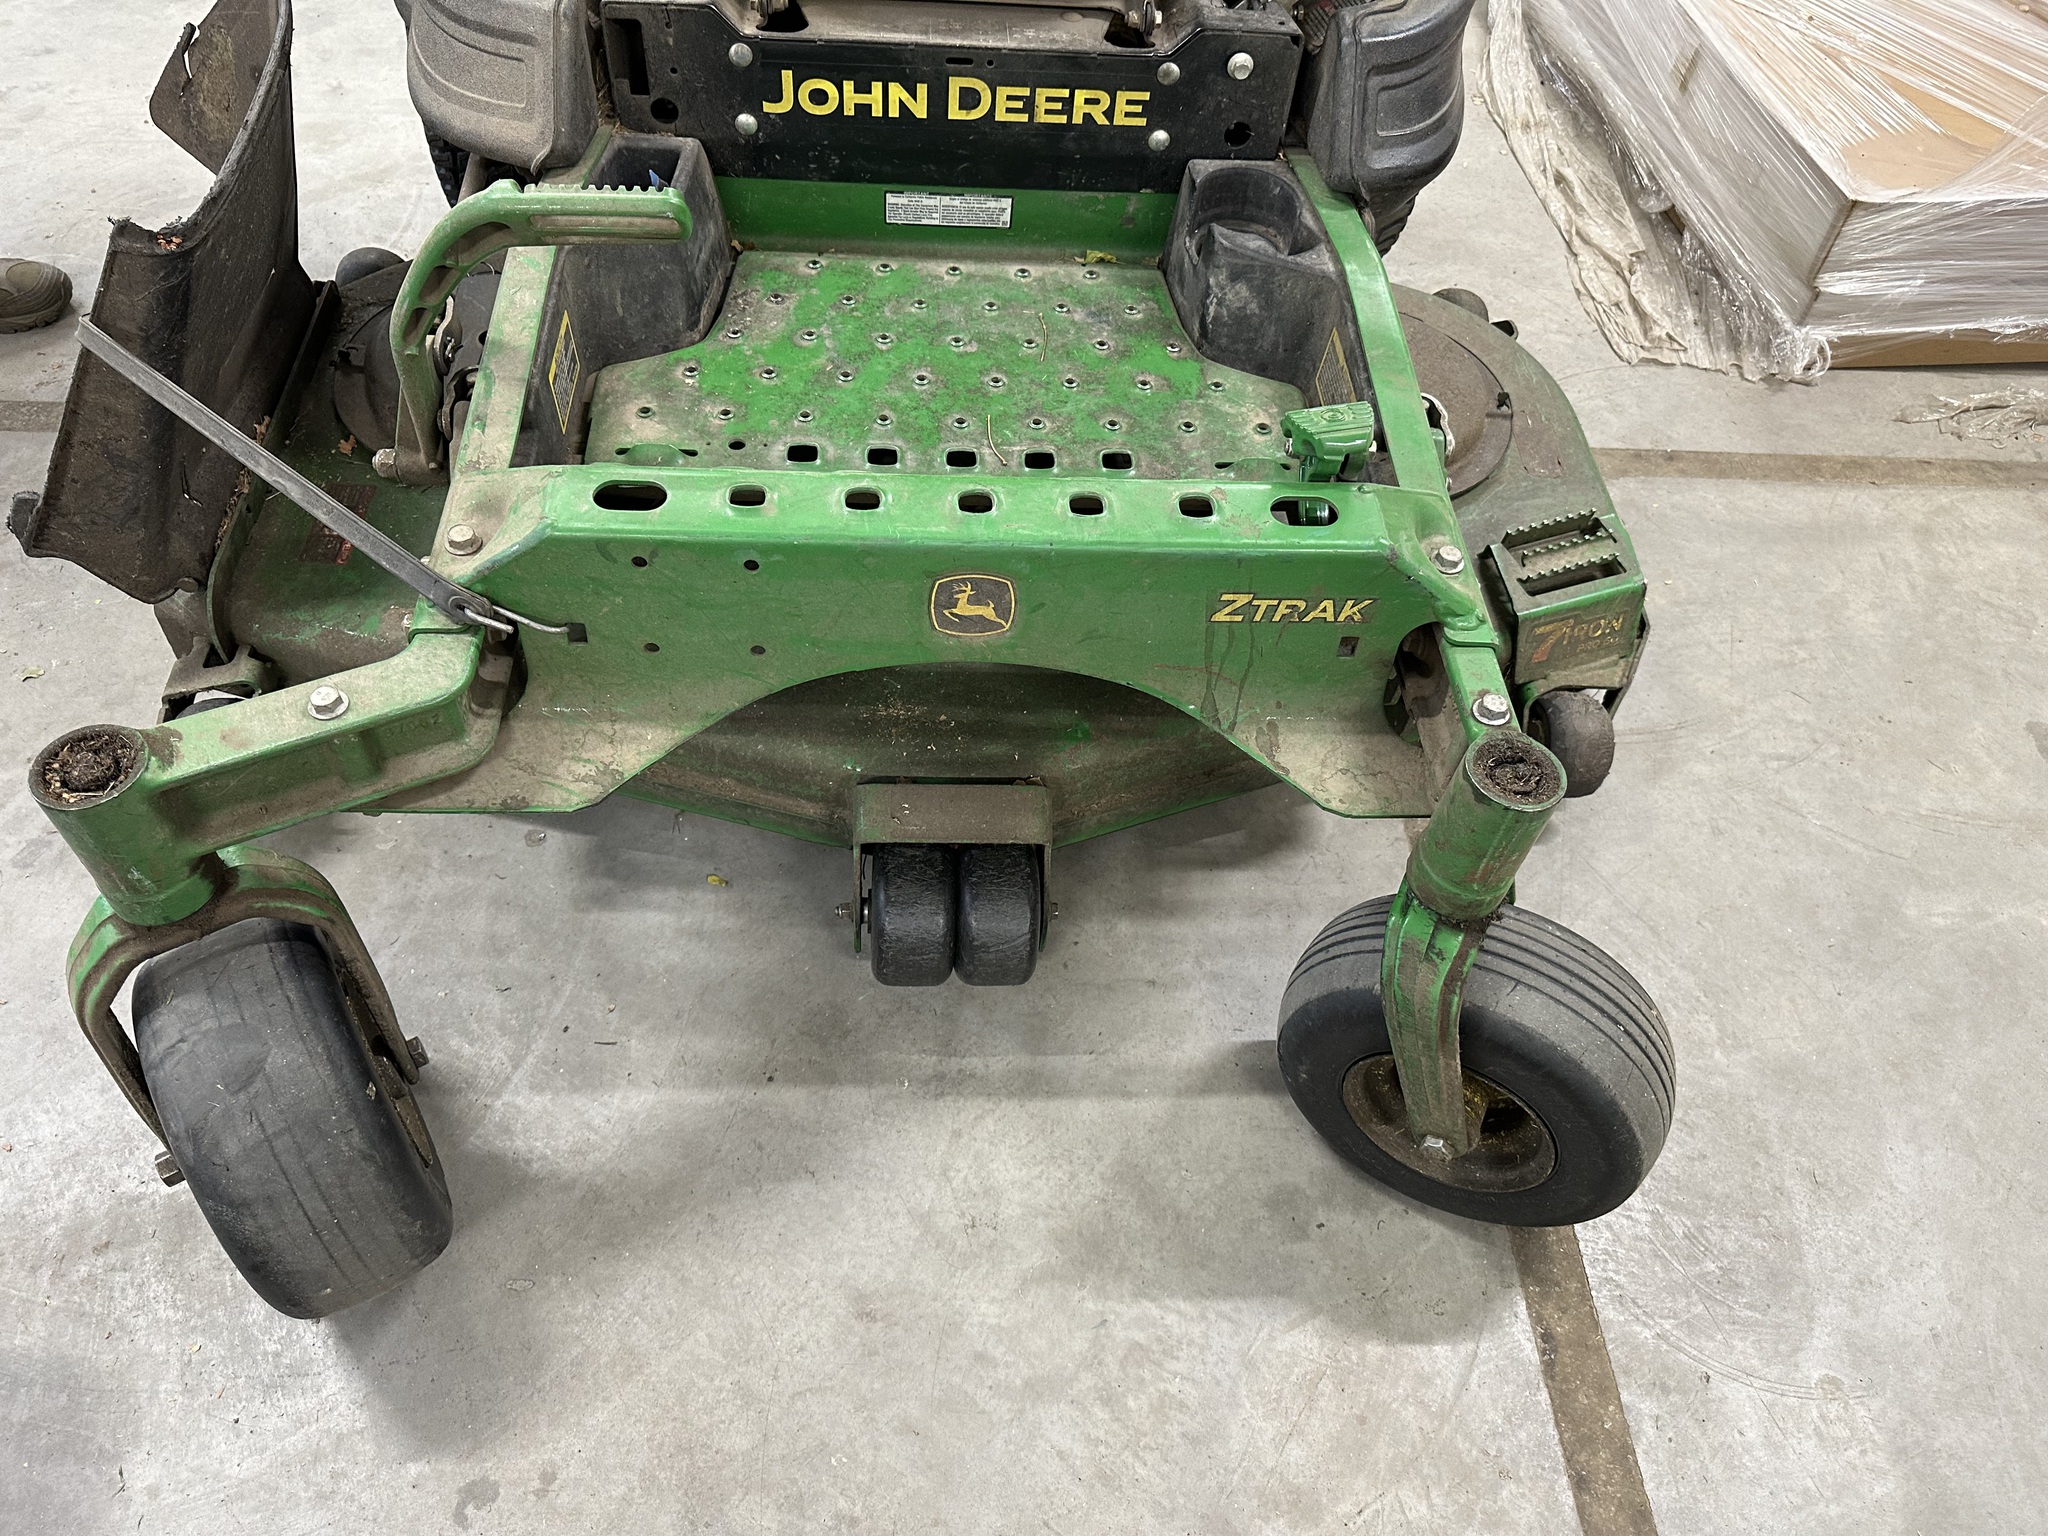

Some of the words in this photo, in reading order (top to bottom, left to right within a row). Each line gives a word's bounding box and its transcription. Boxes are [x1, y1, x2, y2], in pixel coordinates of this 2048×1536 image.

[762, 69, 928, 119] JOHN
[947, 76, 1151, 127] DEERE
[1209, 592, 1376, 623] ZTRAK
